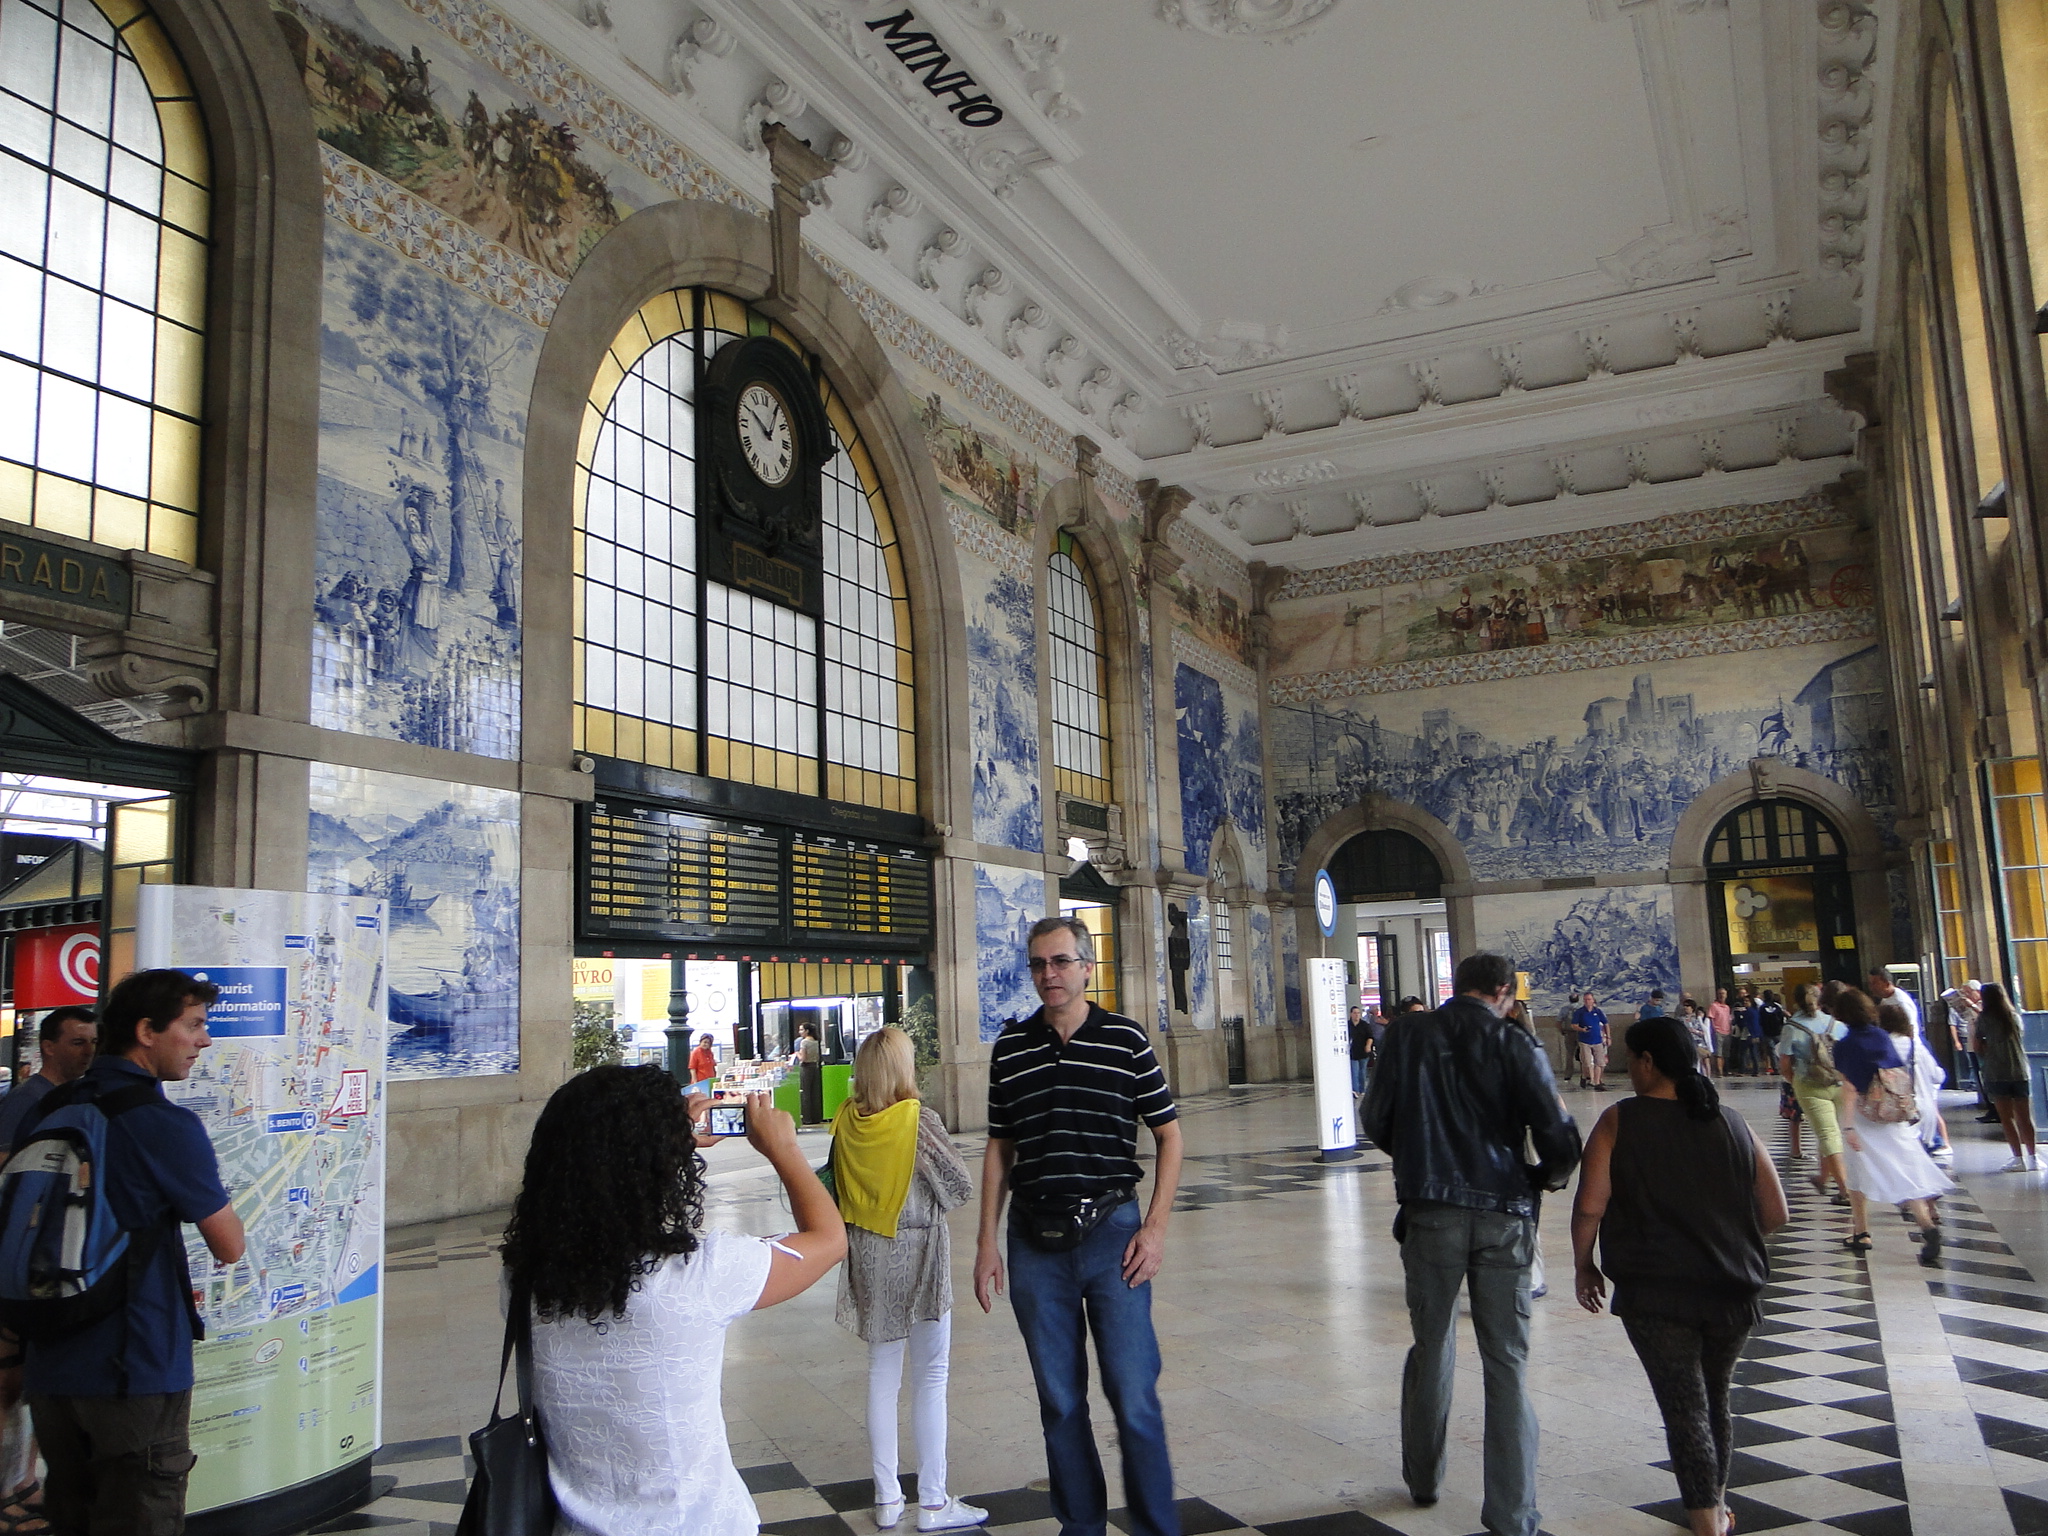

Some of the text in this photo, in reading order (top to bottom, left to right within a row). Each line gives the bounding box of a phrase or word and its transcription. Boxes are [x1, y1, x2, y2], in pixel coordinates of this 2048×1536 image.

[864, 9, 1003, 127] MINHO
[2, 543, 110, 602] RADA
[744, 553, 792, 590] PORTO
[1738, 928, 1813, 943] MOBILIDADE
[212, 982, 254, 995] ourist
[349, 1075, 361, 1086] YOU
[349, 1087, 361, 1099] ARE
[277, 1118, 301, 1126] BENTO
